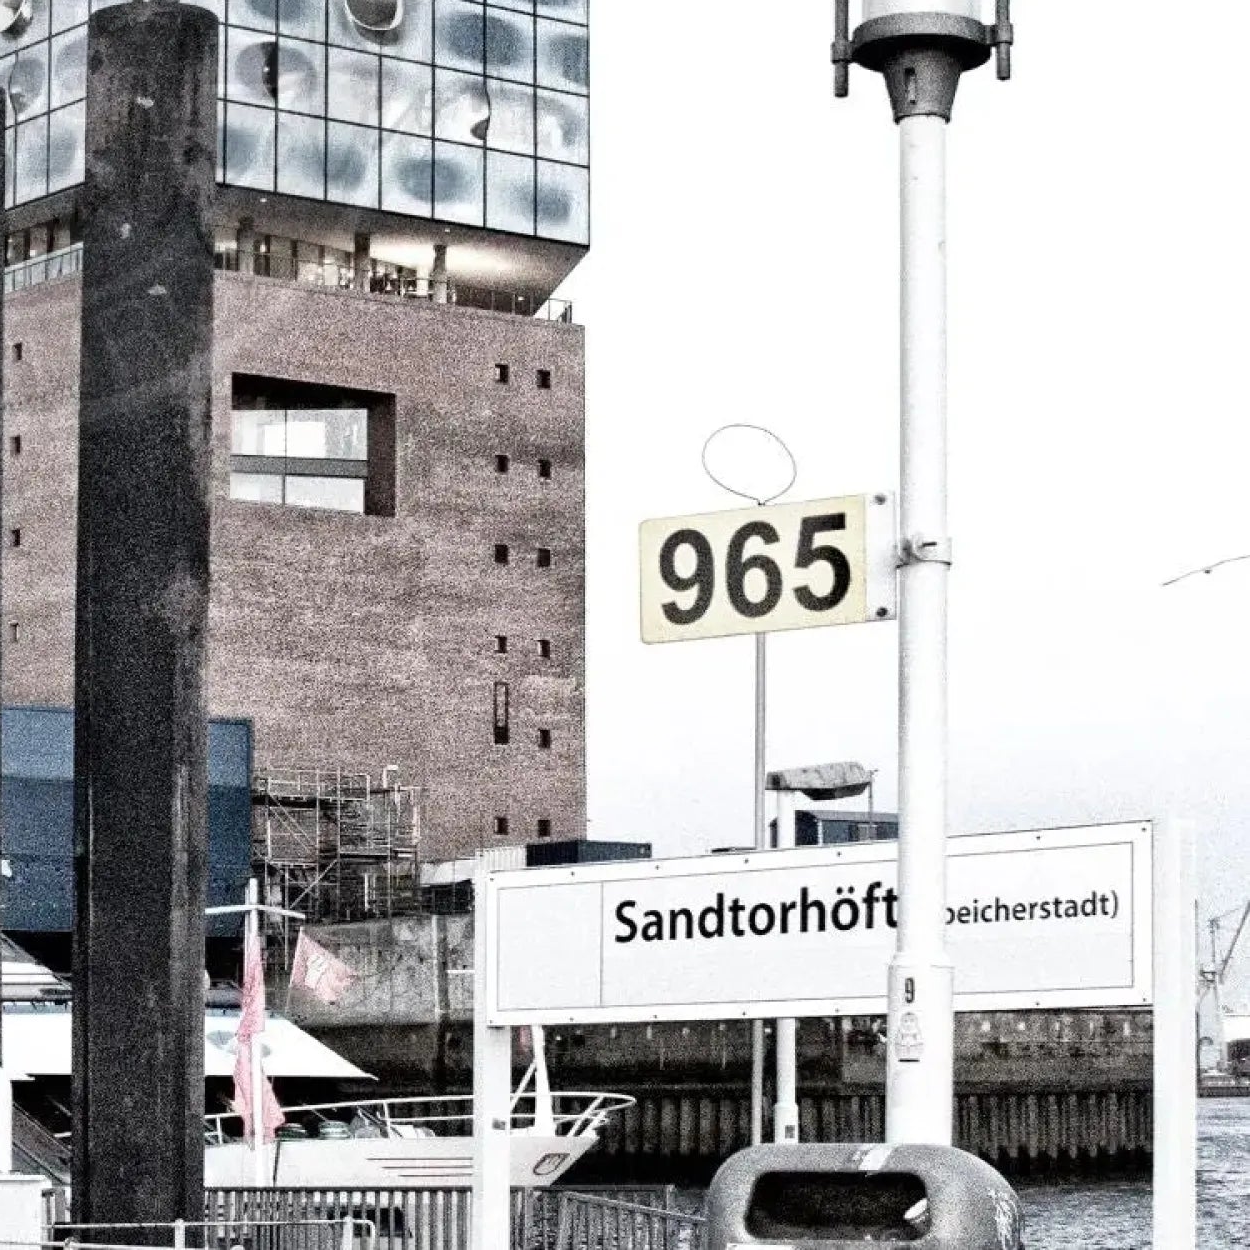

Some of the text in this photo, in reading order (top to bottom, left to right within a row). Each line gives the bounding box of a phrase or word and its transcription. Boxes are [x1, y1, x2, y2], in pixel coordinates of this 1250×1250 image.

[659, 512, 851, 626] 965
[614, 881, 899, 944] Sandtorhöft
[904, 977, 915, 1004] 9
